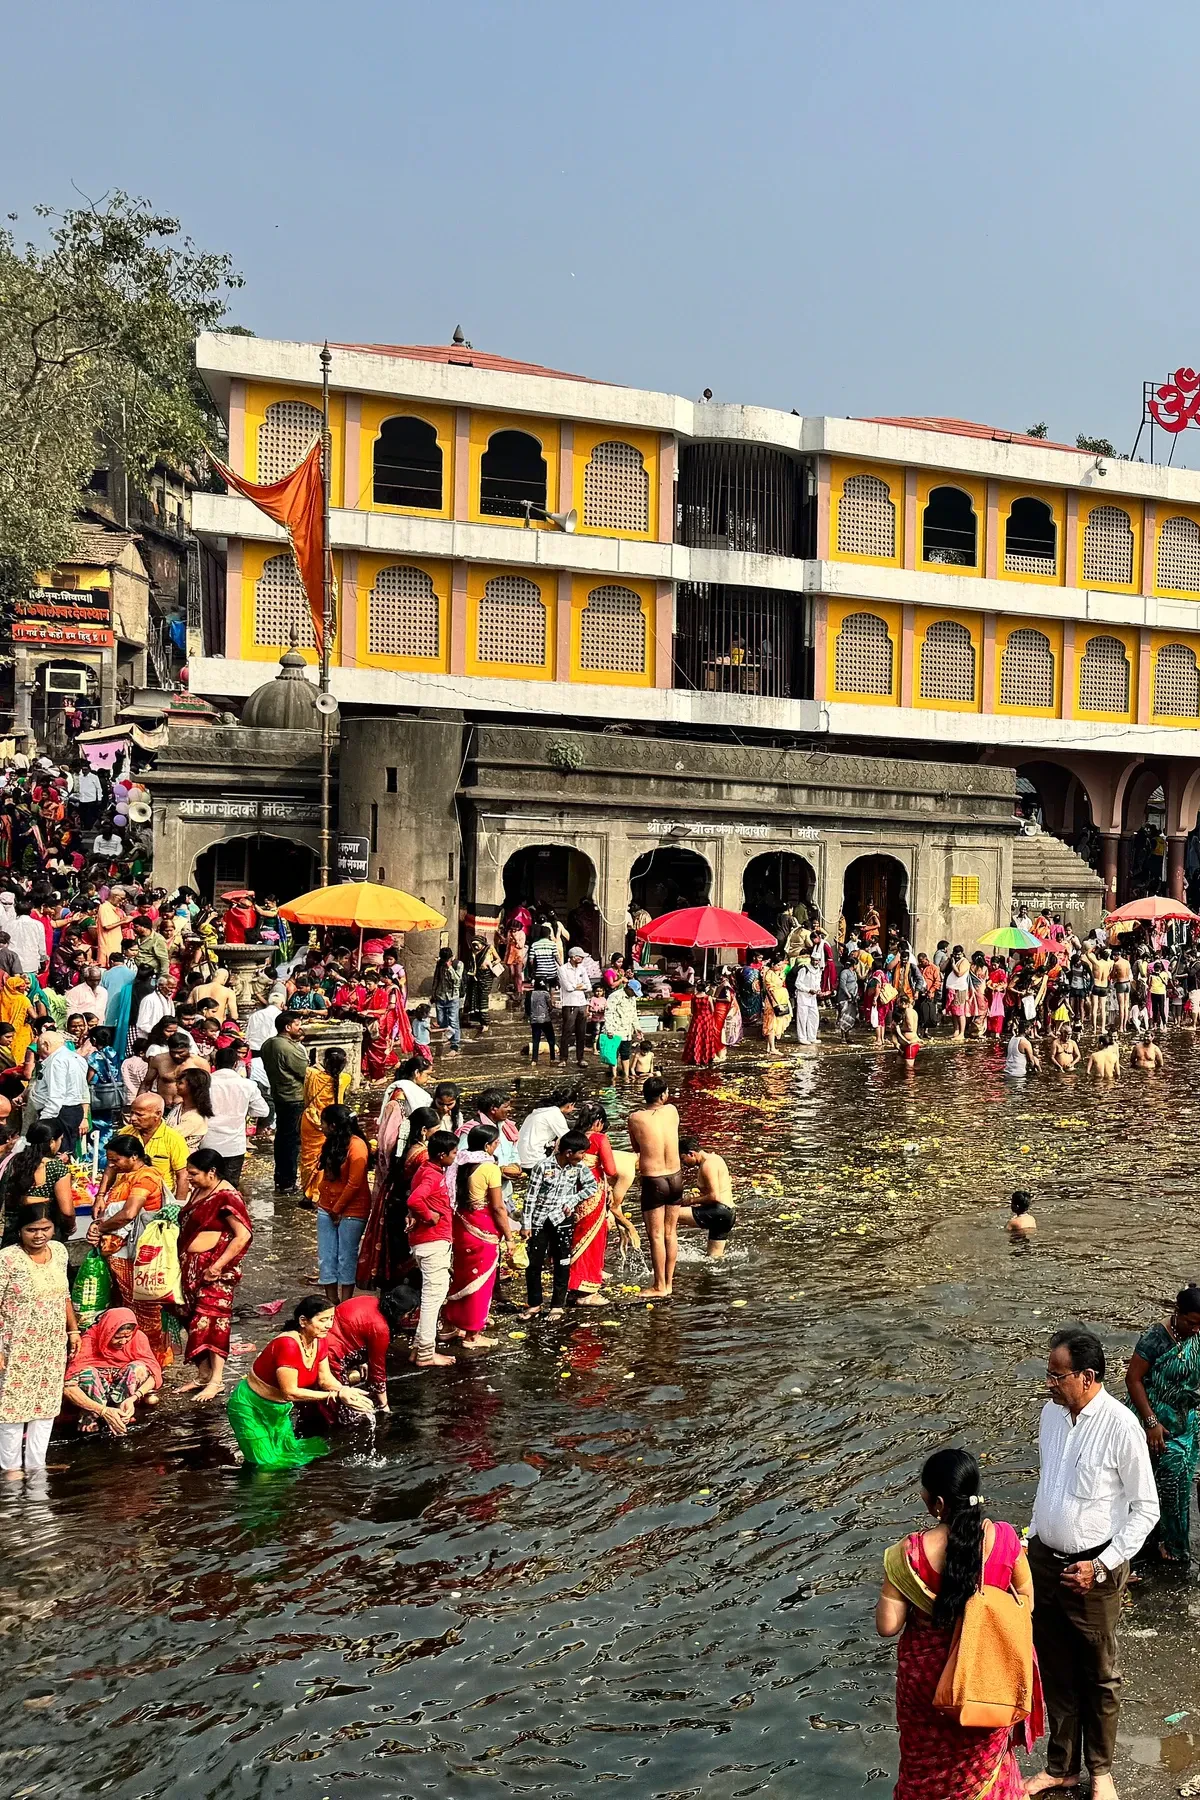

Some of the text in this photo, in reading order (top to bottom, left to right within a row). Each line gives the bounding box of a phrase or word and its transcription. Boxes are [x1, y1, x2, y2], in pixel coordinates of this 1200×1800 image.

[65, 632, 76, 640] हम
[178, 799, 194, 814] श्री
[195, 800, 218, 815] गंगा
[218, 801, 258, 818] गोदावरी
[262, 802, 295, 818] मंदिर
[647, 819, 660, 834] श्री
[715, 822, 734, 835] गंगा
[734, 822, 769, 838] गोदावरी
[797, 826, 821, 840] मंदीर
[1065, 898, 1086, 912] मंदिर
